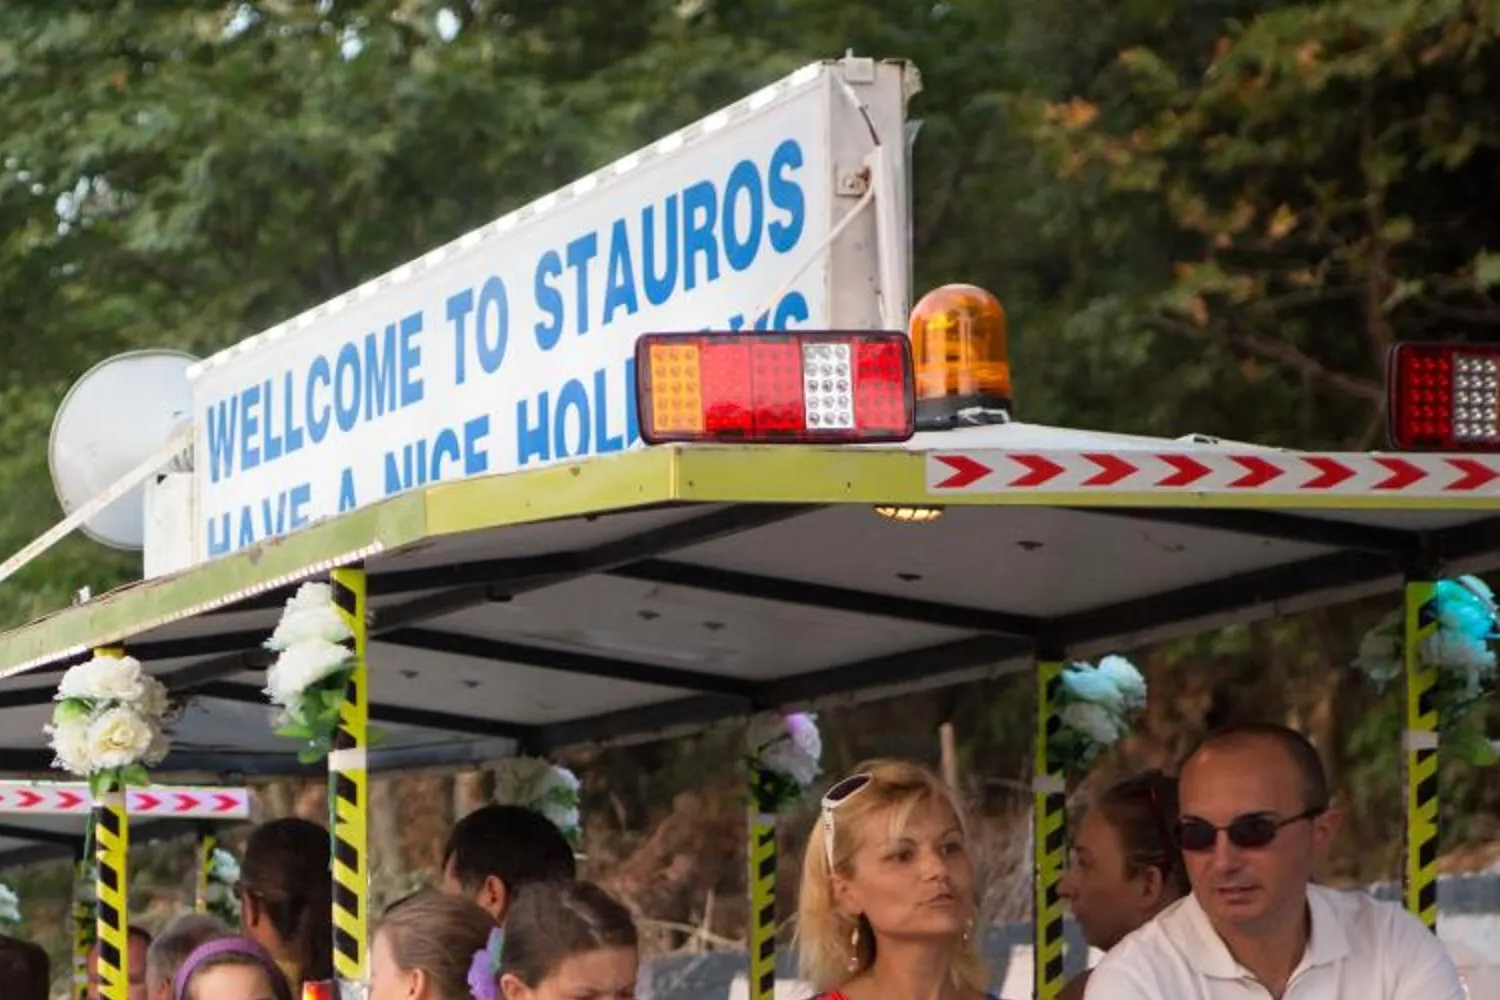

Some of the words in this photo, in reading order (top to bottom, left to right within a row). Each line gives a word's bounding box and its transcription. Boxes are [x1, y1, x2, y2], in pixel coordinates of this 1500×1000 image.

[206, 310, 425, 484] WELLCOME
[445, 274, 509, 386] TO
[533, 137, 806, 352] STAUROS
